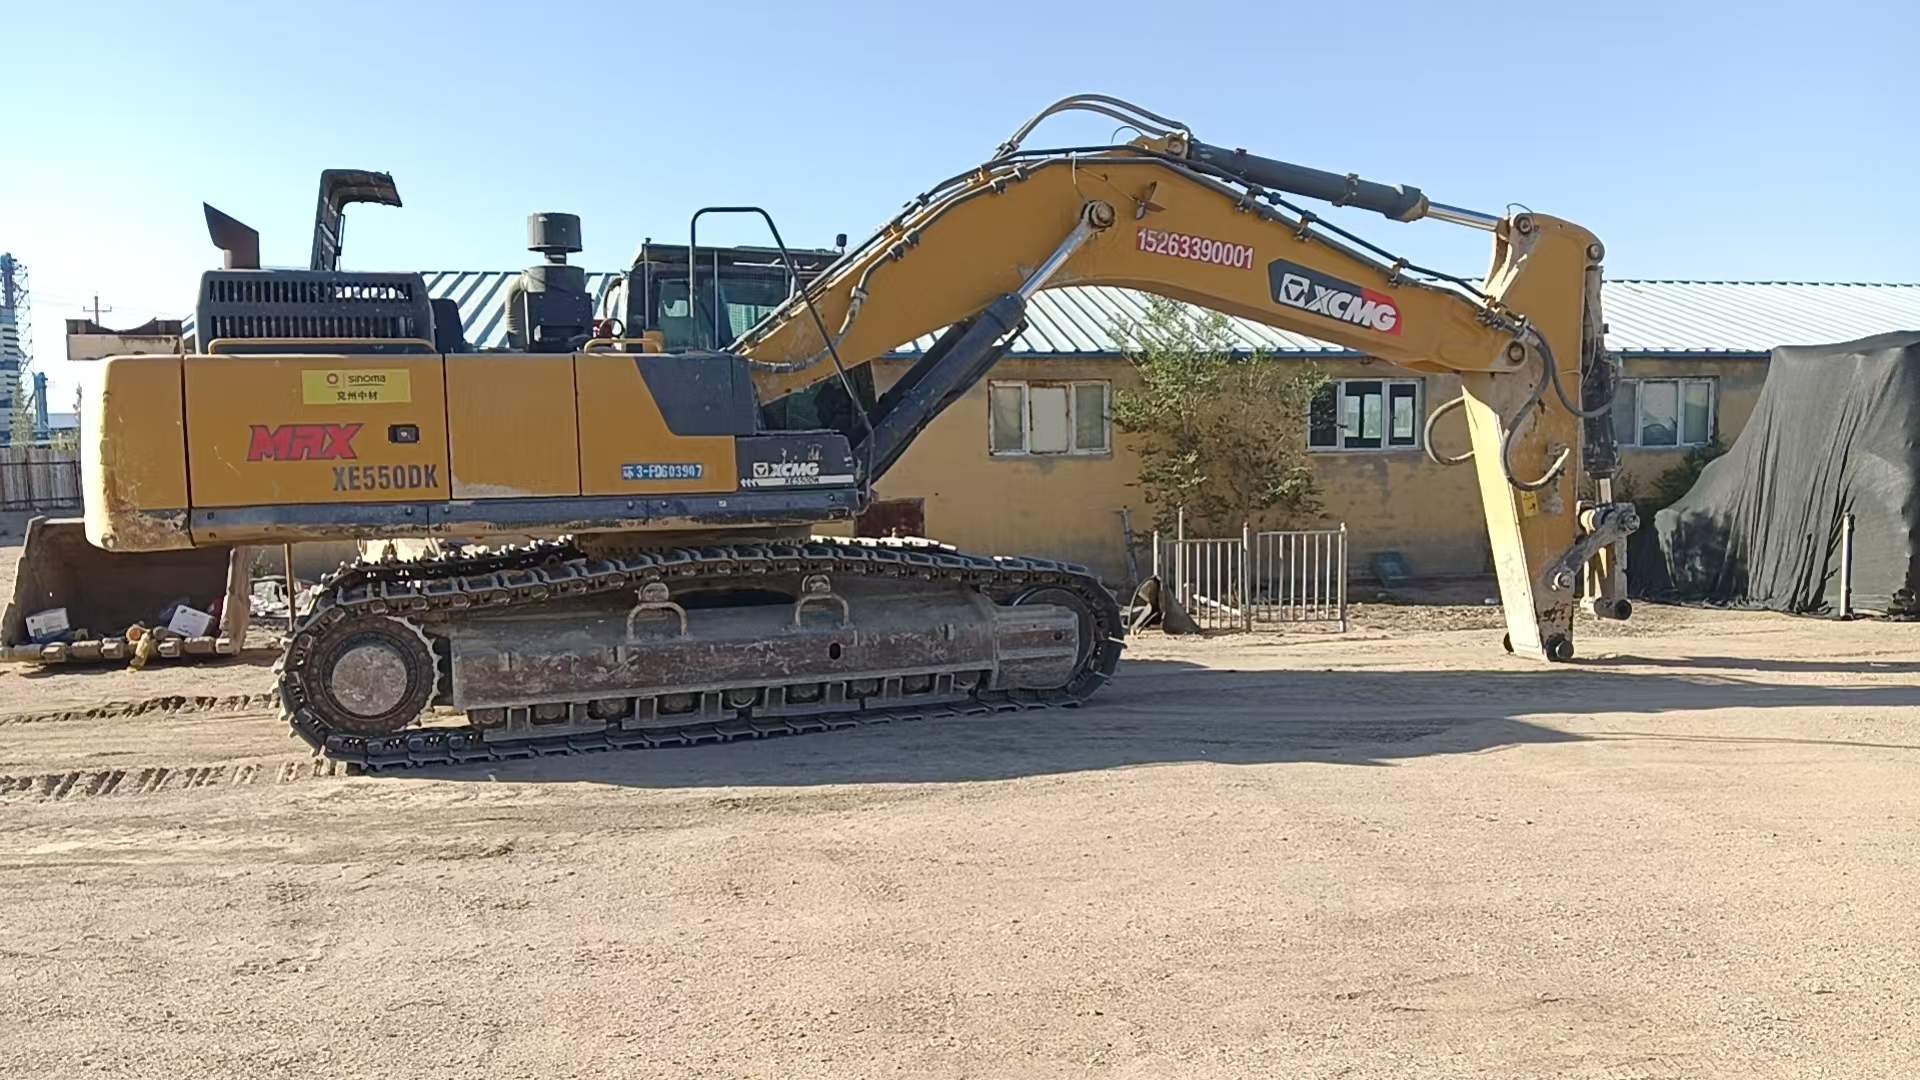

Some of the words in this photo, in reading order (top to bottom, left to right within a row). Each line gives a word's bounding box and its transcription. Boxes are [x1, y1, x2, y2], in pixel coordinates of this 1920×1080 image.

[1138, 229, 1255, 269] 15263390001
[1305, 285, 1397, 331] XCMG
[348, 373, 387, 384] sinoma
[247, 423, 364, 461] MAX
[333, 465, 438, 491] XE550DK
[769, 462, 820, 477] XCMG
